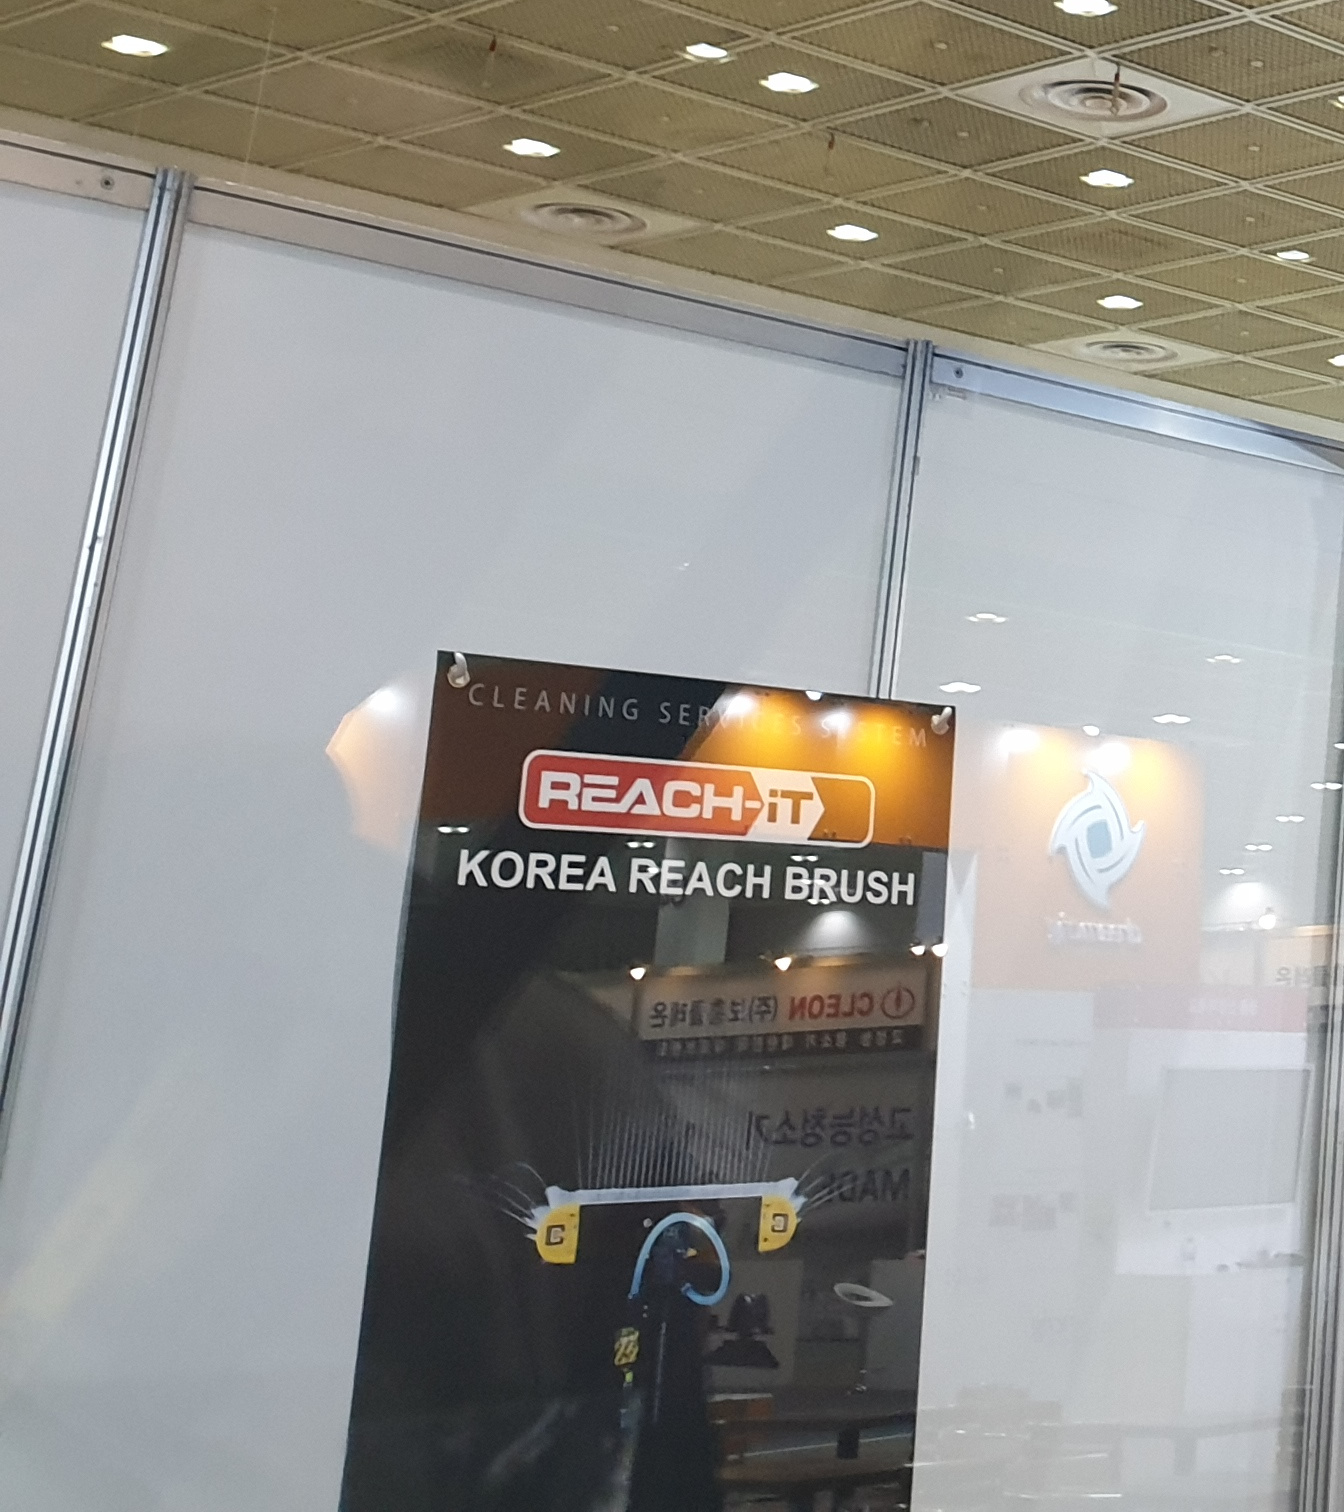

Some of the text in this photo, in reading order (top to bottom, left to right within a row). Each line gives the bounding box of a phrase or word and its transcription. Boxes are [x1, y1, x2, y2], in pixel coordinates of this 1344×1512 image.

[467, 683, 640, 721] CLEANING
[659, 702, 802, 736] SERVICES
[457, 849, 916, 906] KOREA REACH BRUSH
